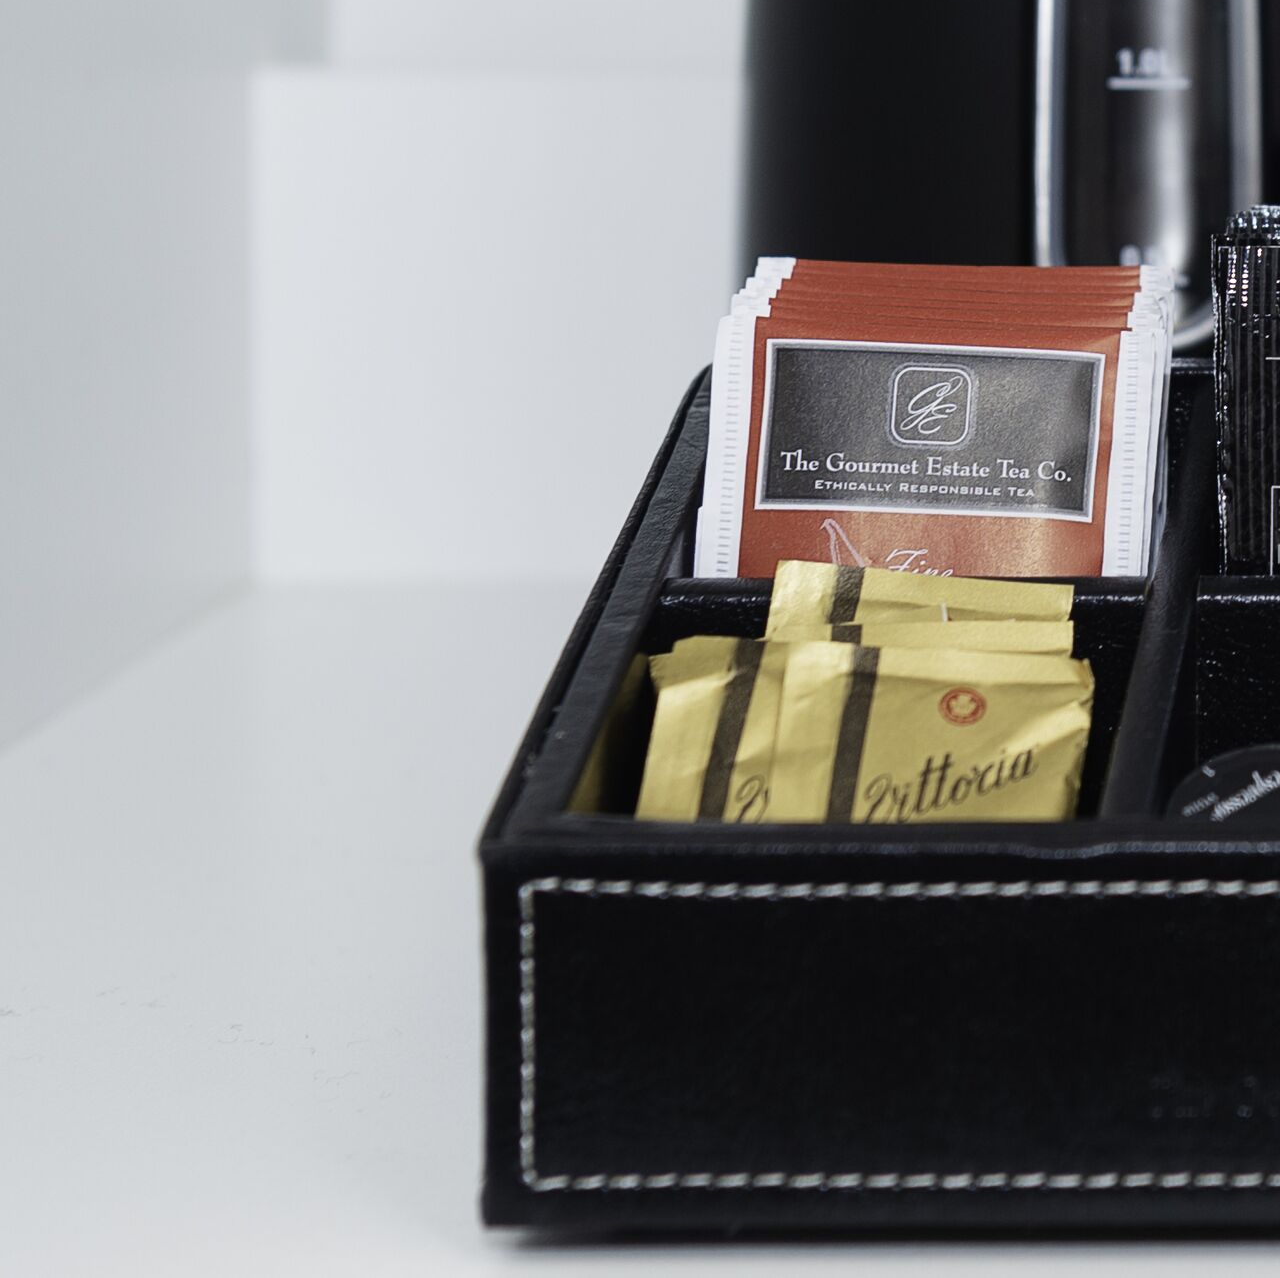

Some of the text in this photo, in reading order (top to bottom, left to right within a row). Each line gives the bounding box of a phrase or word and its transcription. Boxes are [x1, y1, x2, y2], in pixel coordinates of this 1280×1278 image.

[780, 449, 1073, 483] The Gourmet Estate Tea Co.
[815, 479, 1036, 498] ETHICALLY RESPONSIBLE TEA
[864, 743, 1040, 823] Vittoria
